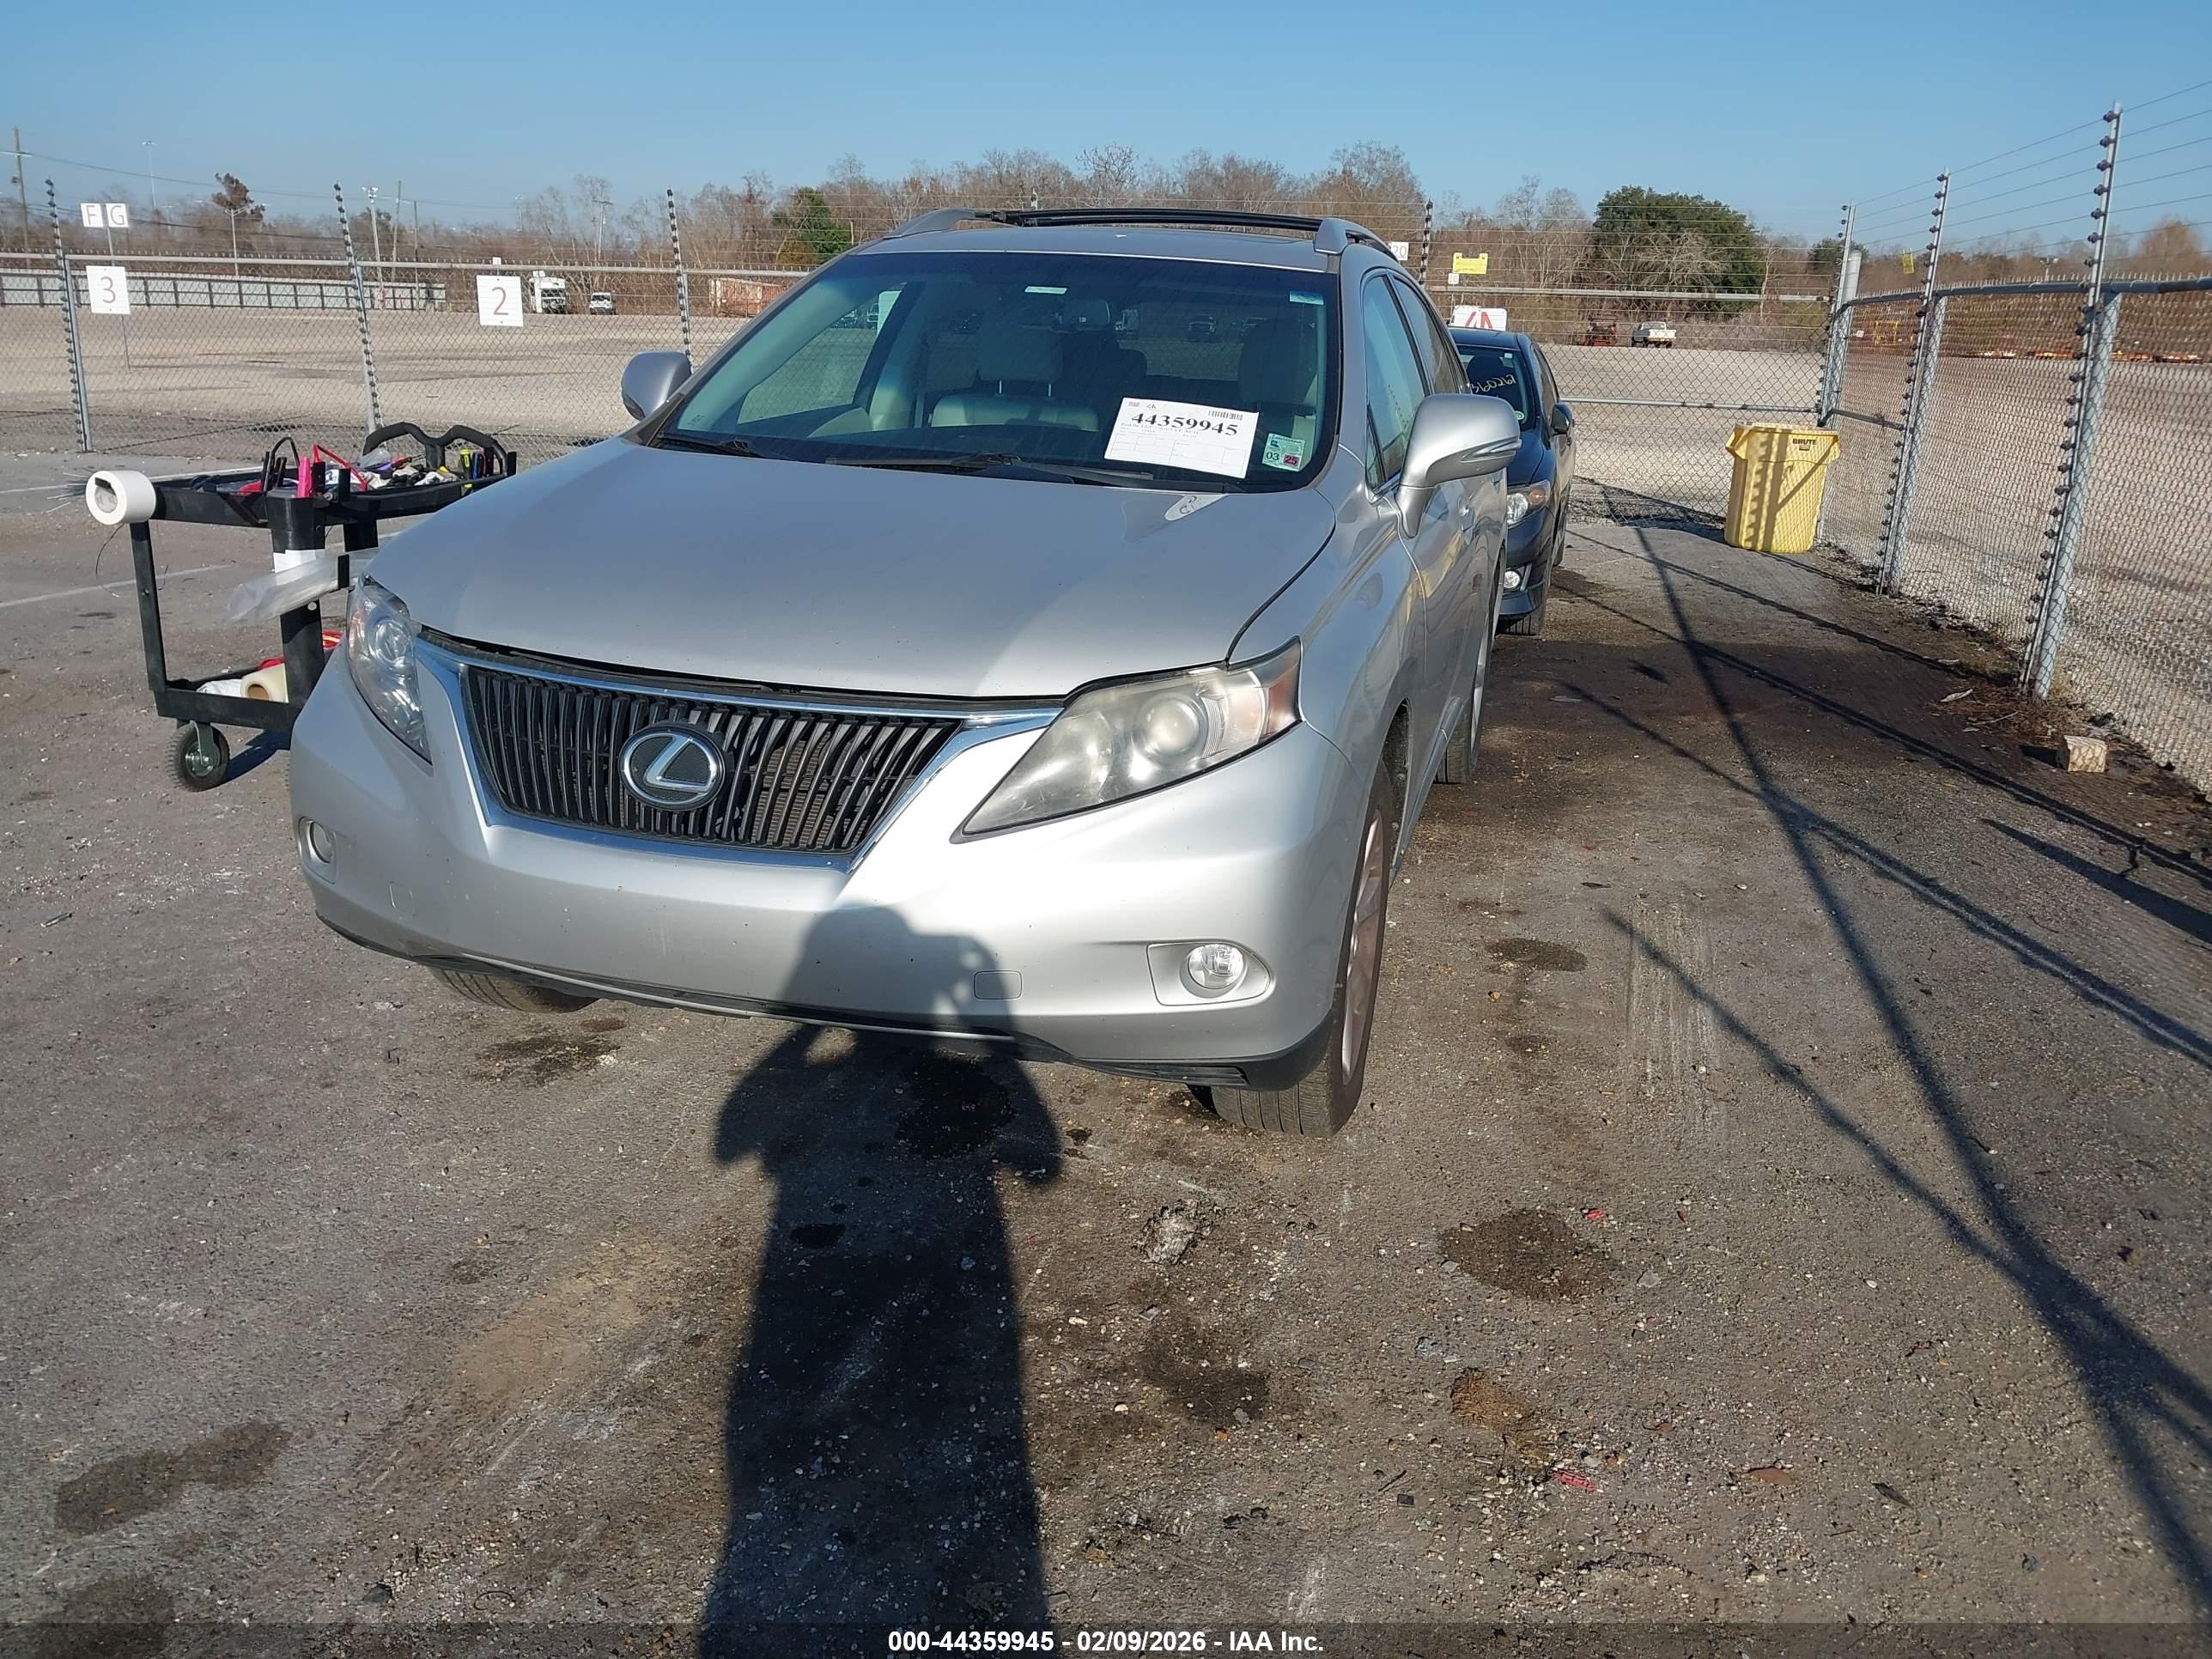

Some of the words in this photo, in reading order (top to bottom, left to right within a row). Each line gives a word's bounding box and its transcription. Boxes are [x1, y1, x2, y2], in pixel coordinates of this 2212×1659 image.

[86, 205, 95, 225] F
[110, 205, 125, 225] G
[100, 276, 116, 303] 3
[492, 286, 509, 315] 2
[1131, 413, 1238, 436] 44359945
[1266, 451, 1279, 461] 03
[1284, 455, 1297, 465] 25
